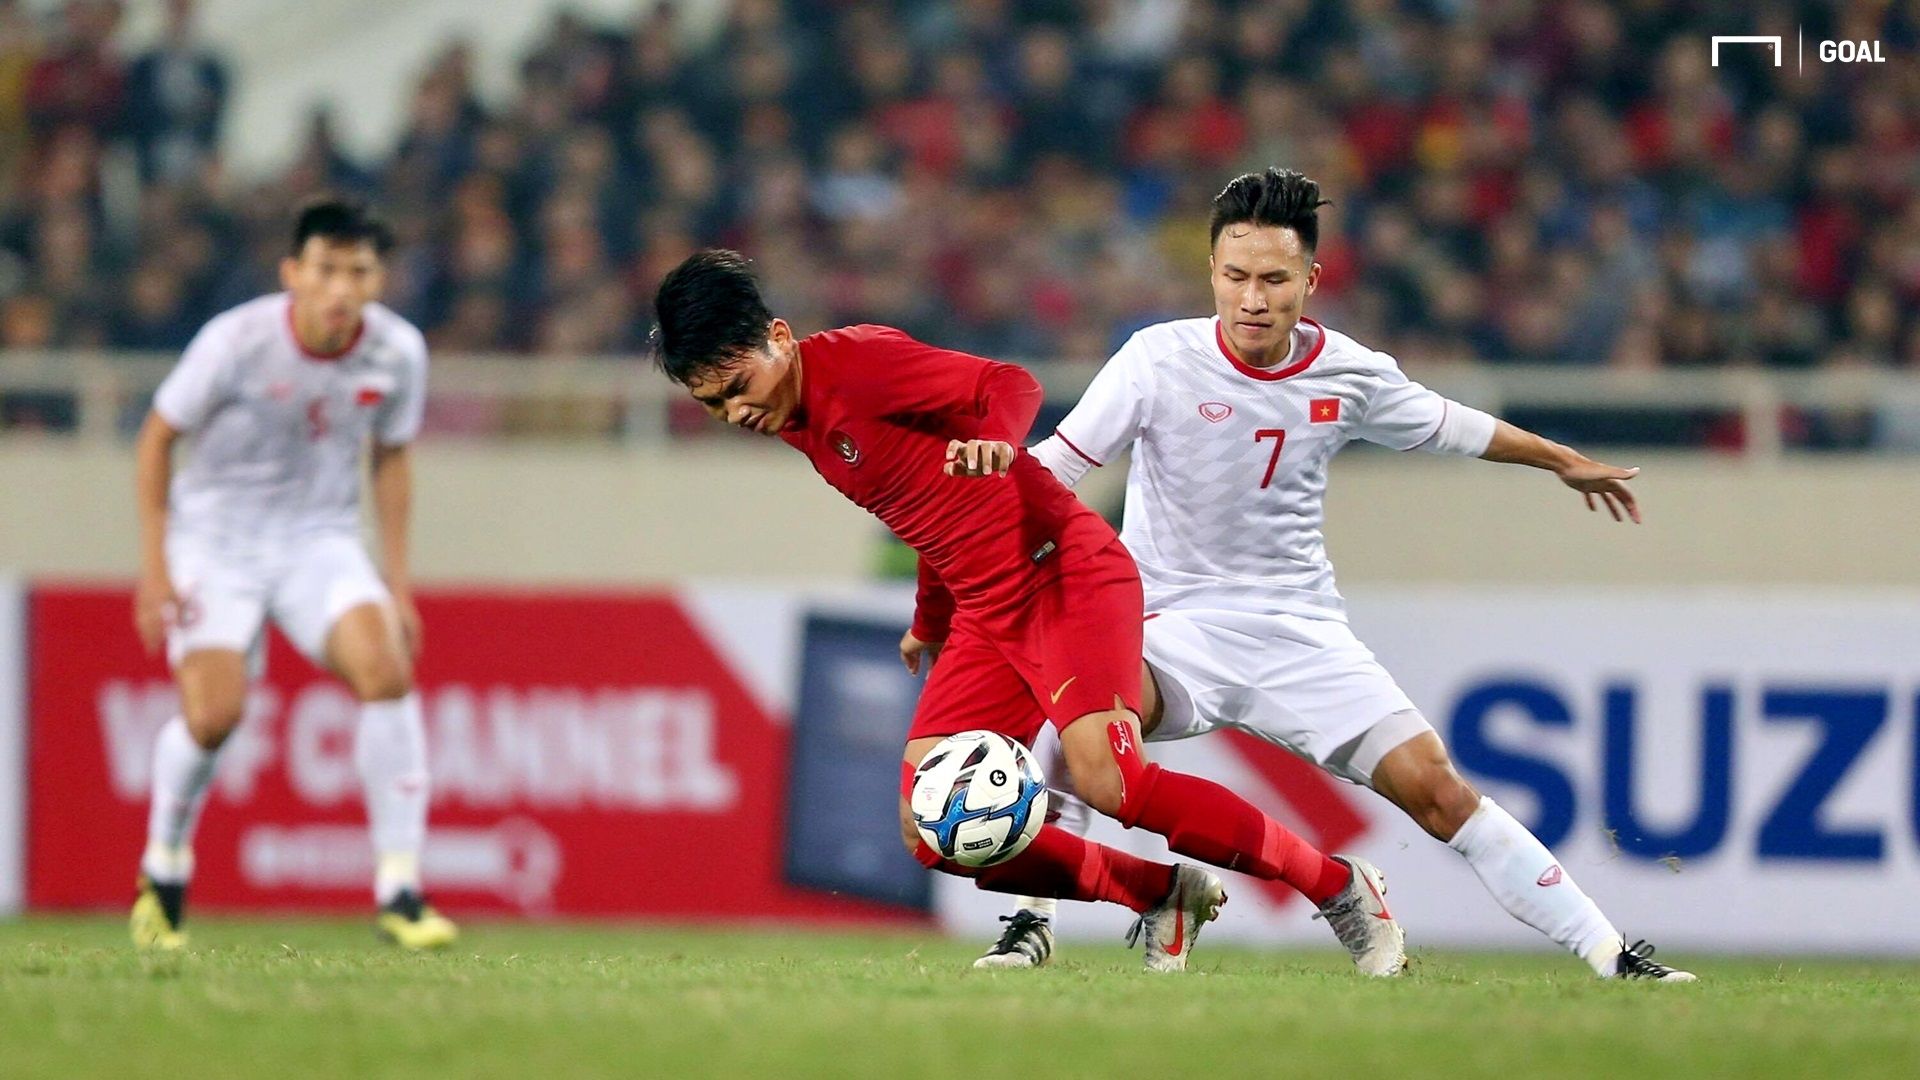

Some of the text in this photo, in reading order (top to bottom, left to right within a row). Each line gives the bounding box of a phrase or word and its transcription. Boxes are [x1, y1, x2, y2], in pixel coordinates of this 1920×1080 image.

[1254, 429, 1286, 489] 7
[97, 680, 740, 809] VF CANNEL
[1448, 672, 1920, 864] SUZ
